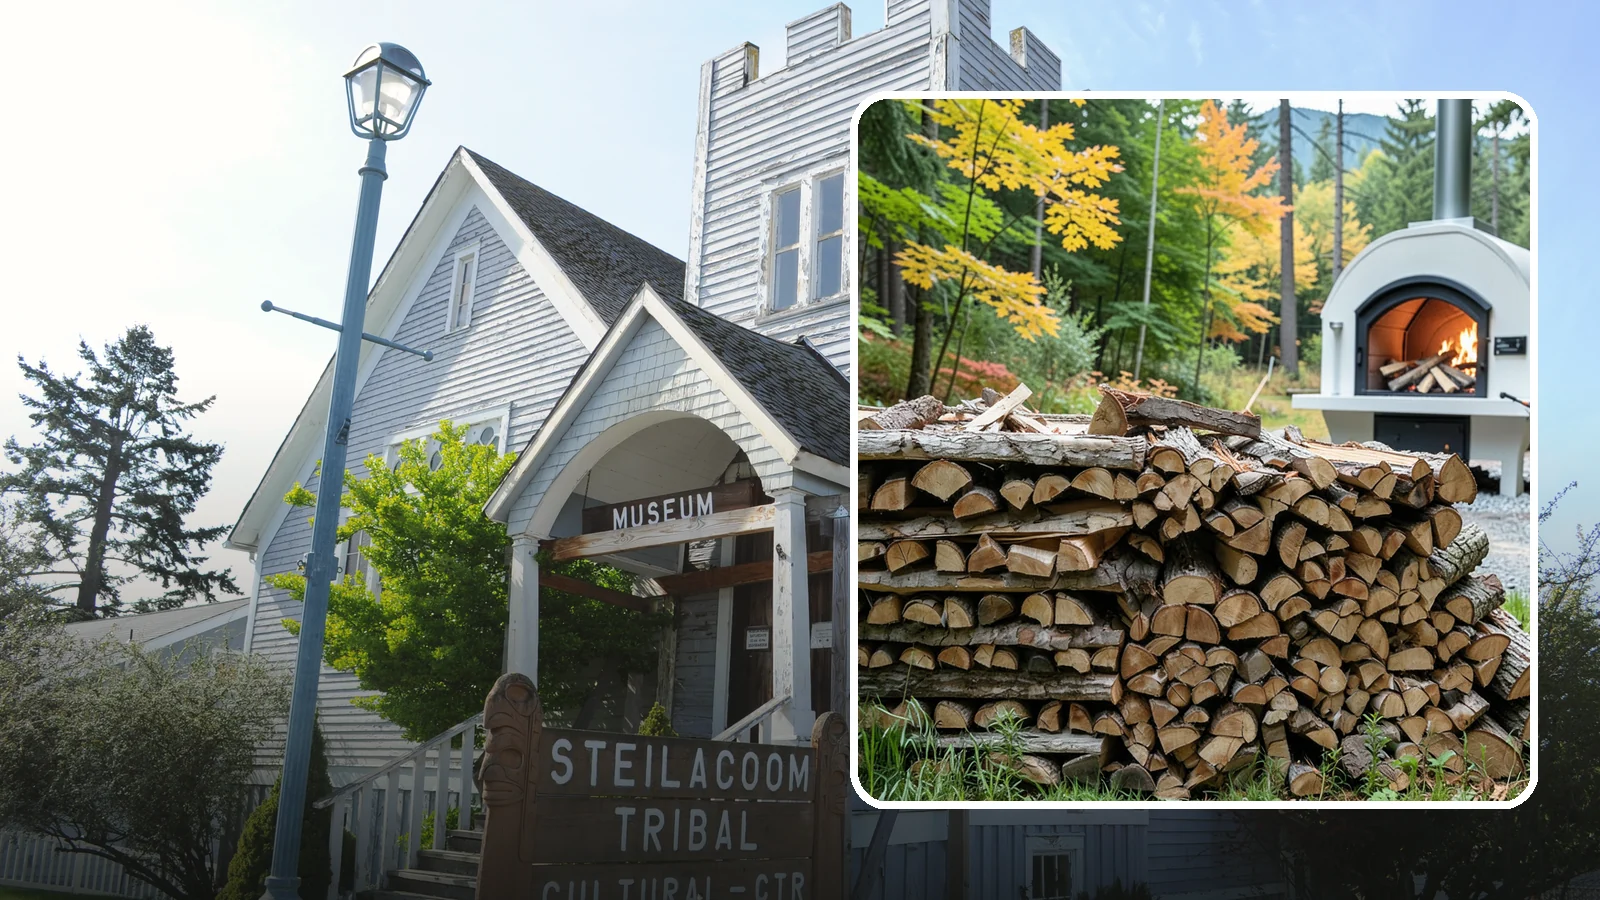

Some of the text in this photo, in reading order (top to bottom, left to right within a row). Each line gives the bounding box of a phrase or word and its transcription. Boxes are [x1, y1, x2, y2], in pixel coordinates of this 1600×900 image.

[612, 491, 714, 531] MUSEUM
[550, 738, 809, 793] STEILACOOM
[614, 806, 758, 852] TRIBAL
